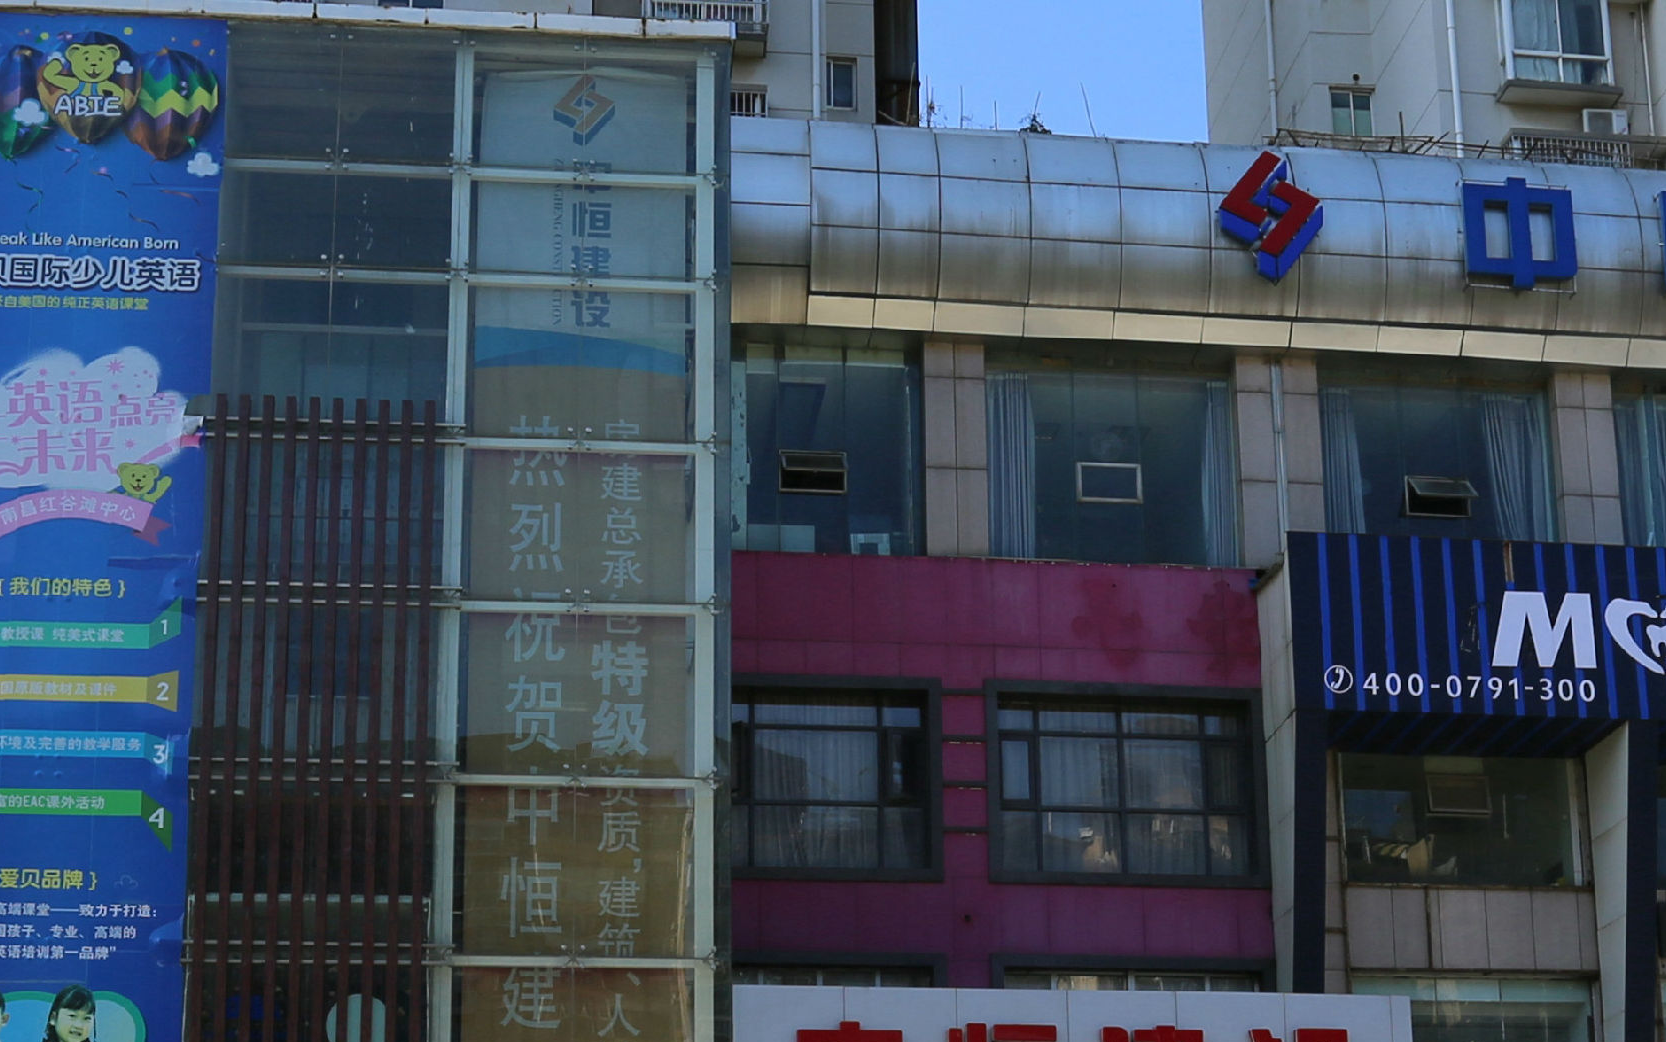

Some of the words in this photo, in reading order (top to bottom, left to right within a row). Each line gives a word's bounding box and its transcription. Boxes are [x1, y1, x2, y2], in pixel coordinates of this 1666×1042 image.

[53, 95, 122, 117] ABIE
[31, 232, 62, 247] Like
[65, 234, 139, 249] American
[143, 235, 179, 250] Born
[17, 428, 120, 477] 未来
[0, 494, 137, 525] 南昌红谷滩中心
[159, 619, 169, 635] 1
[156, 682, 169, 701] 2
[1363, 672, 1596, 702] 400-0791-300
[153, 745, 165, 764] 3
[148, 807, 165, 829] 4
